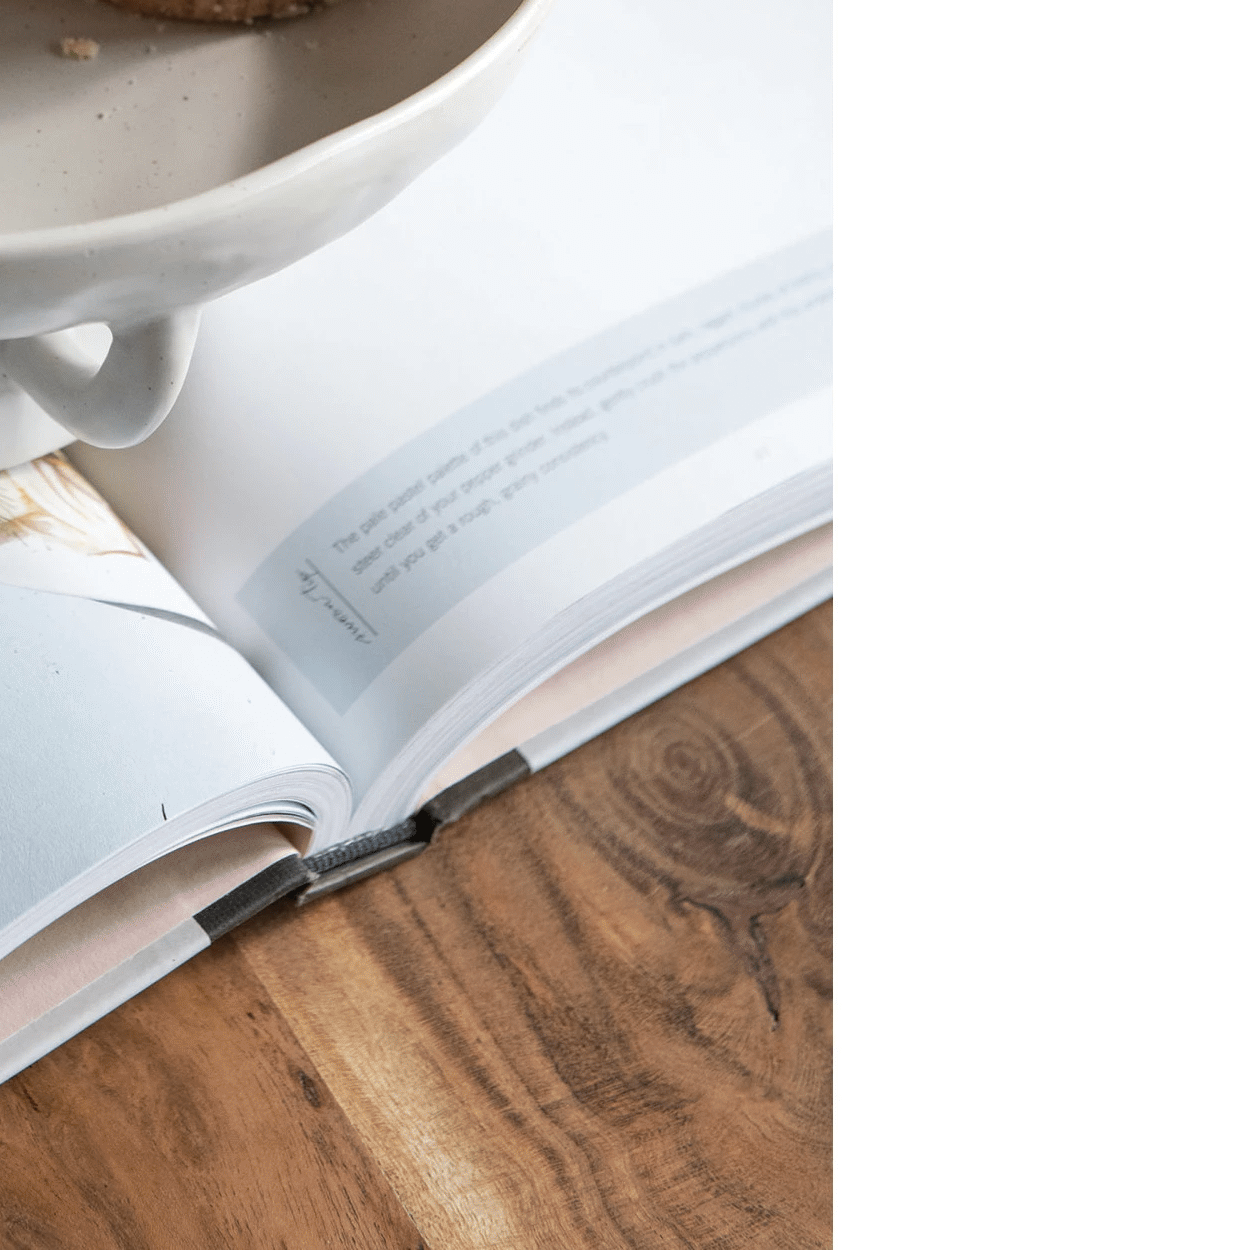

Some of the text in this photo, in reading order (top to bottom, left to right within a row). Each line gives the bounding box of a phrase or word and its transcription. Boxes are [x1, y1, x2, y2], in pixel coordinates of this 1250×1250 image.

[332, 532, 360, 553] The
[388, 479, 425, 513] pastel
[469, 440, 483, 456] of
[416, 507, 430, 524] of
[430, 489, 459, 516] your
[370, 564, 400, 595] until
[400, 547, 426, 572] you
[425, 529, 448, 552] get
[447, 523, 459, 534] a
